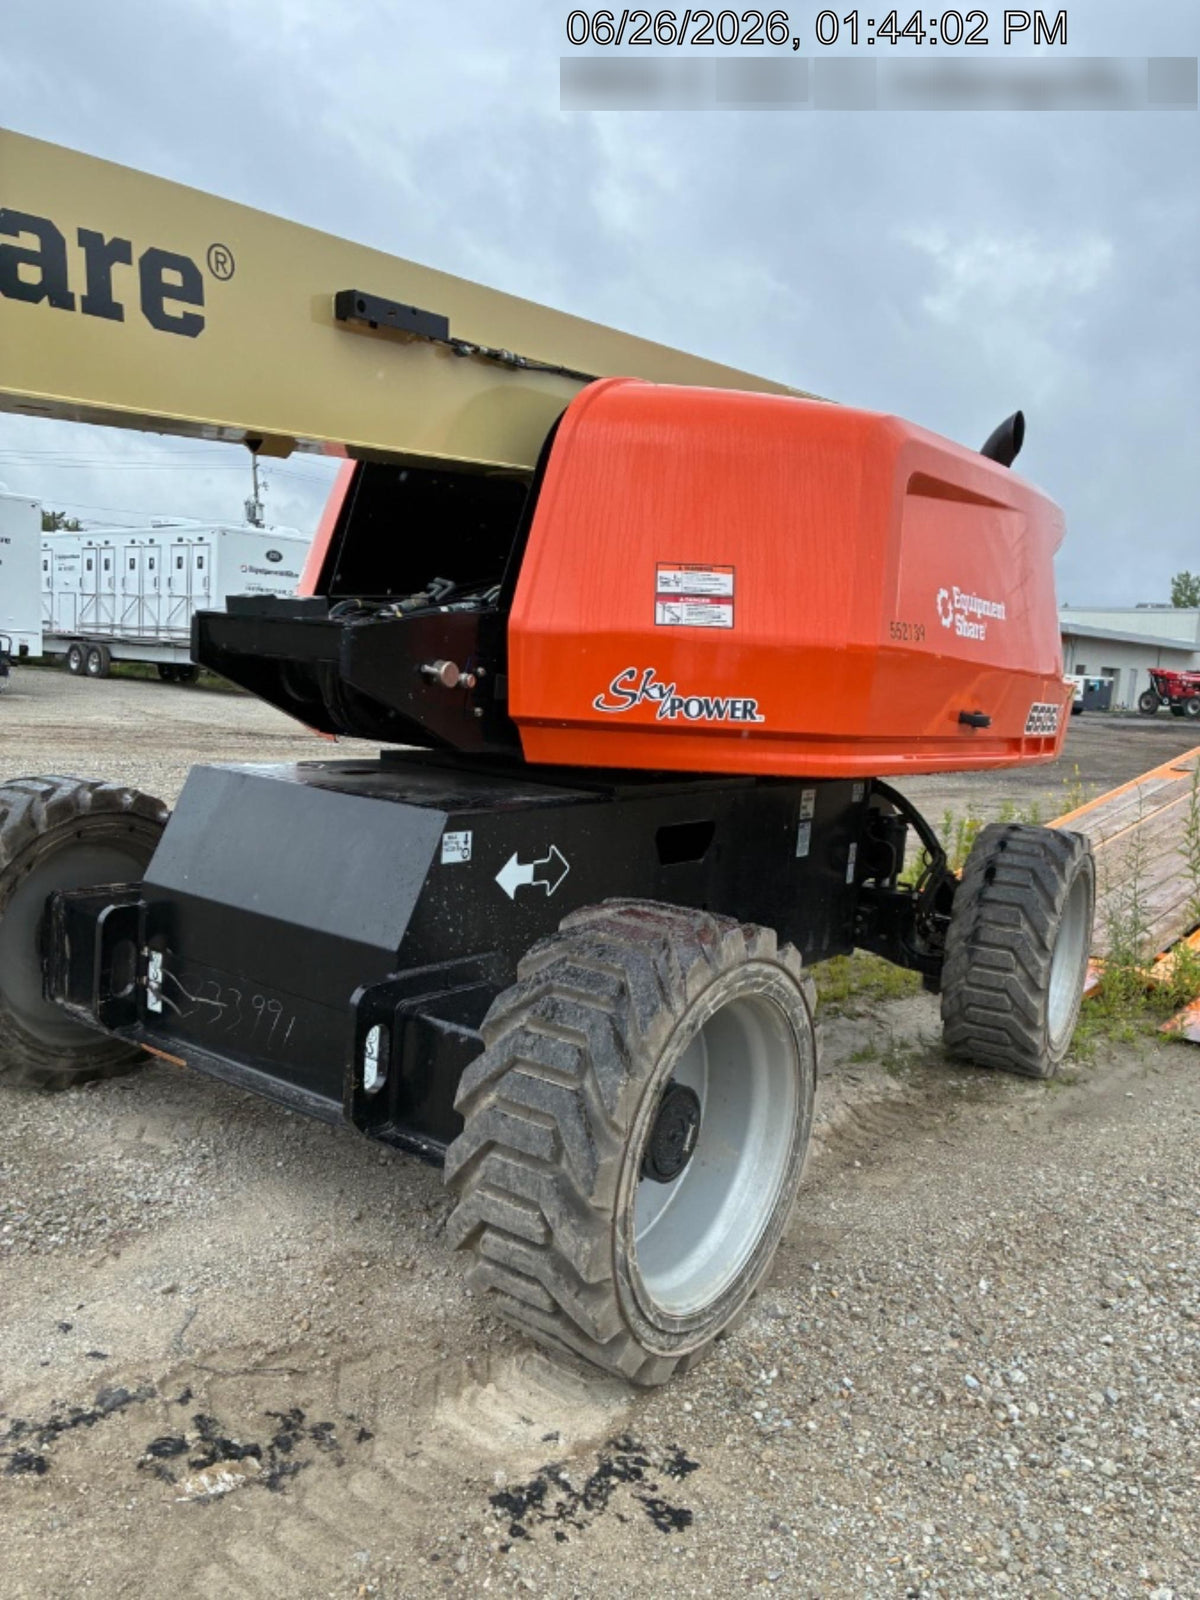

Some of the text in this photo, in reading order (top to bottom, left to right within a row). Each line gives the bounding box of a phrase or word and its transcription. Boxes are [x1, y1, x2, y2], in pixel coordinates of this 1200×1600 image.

[952, 586, 1006, 621] Equipment
[889, 621, 926, 641] 552139
[955, 613, 986, 640] Share
